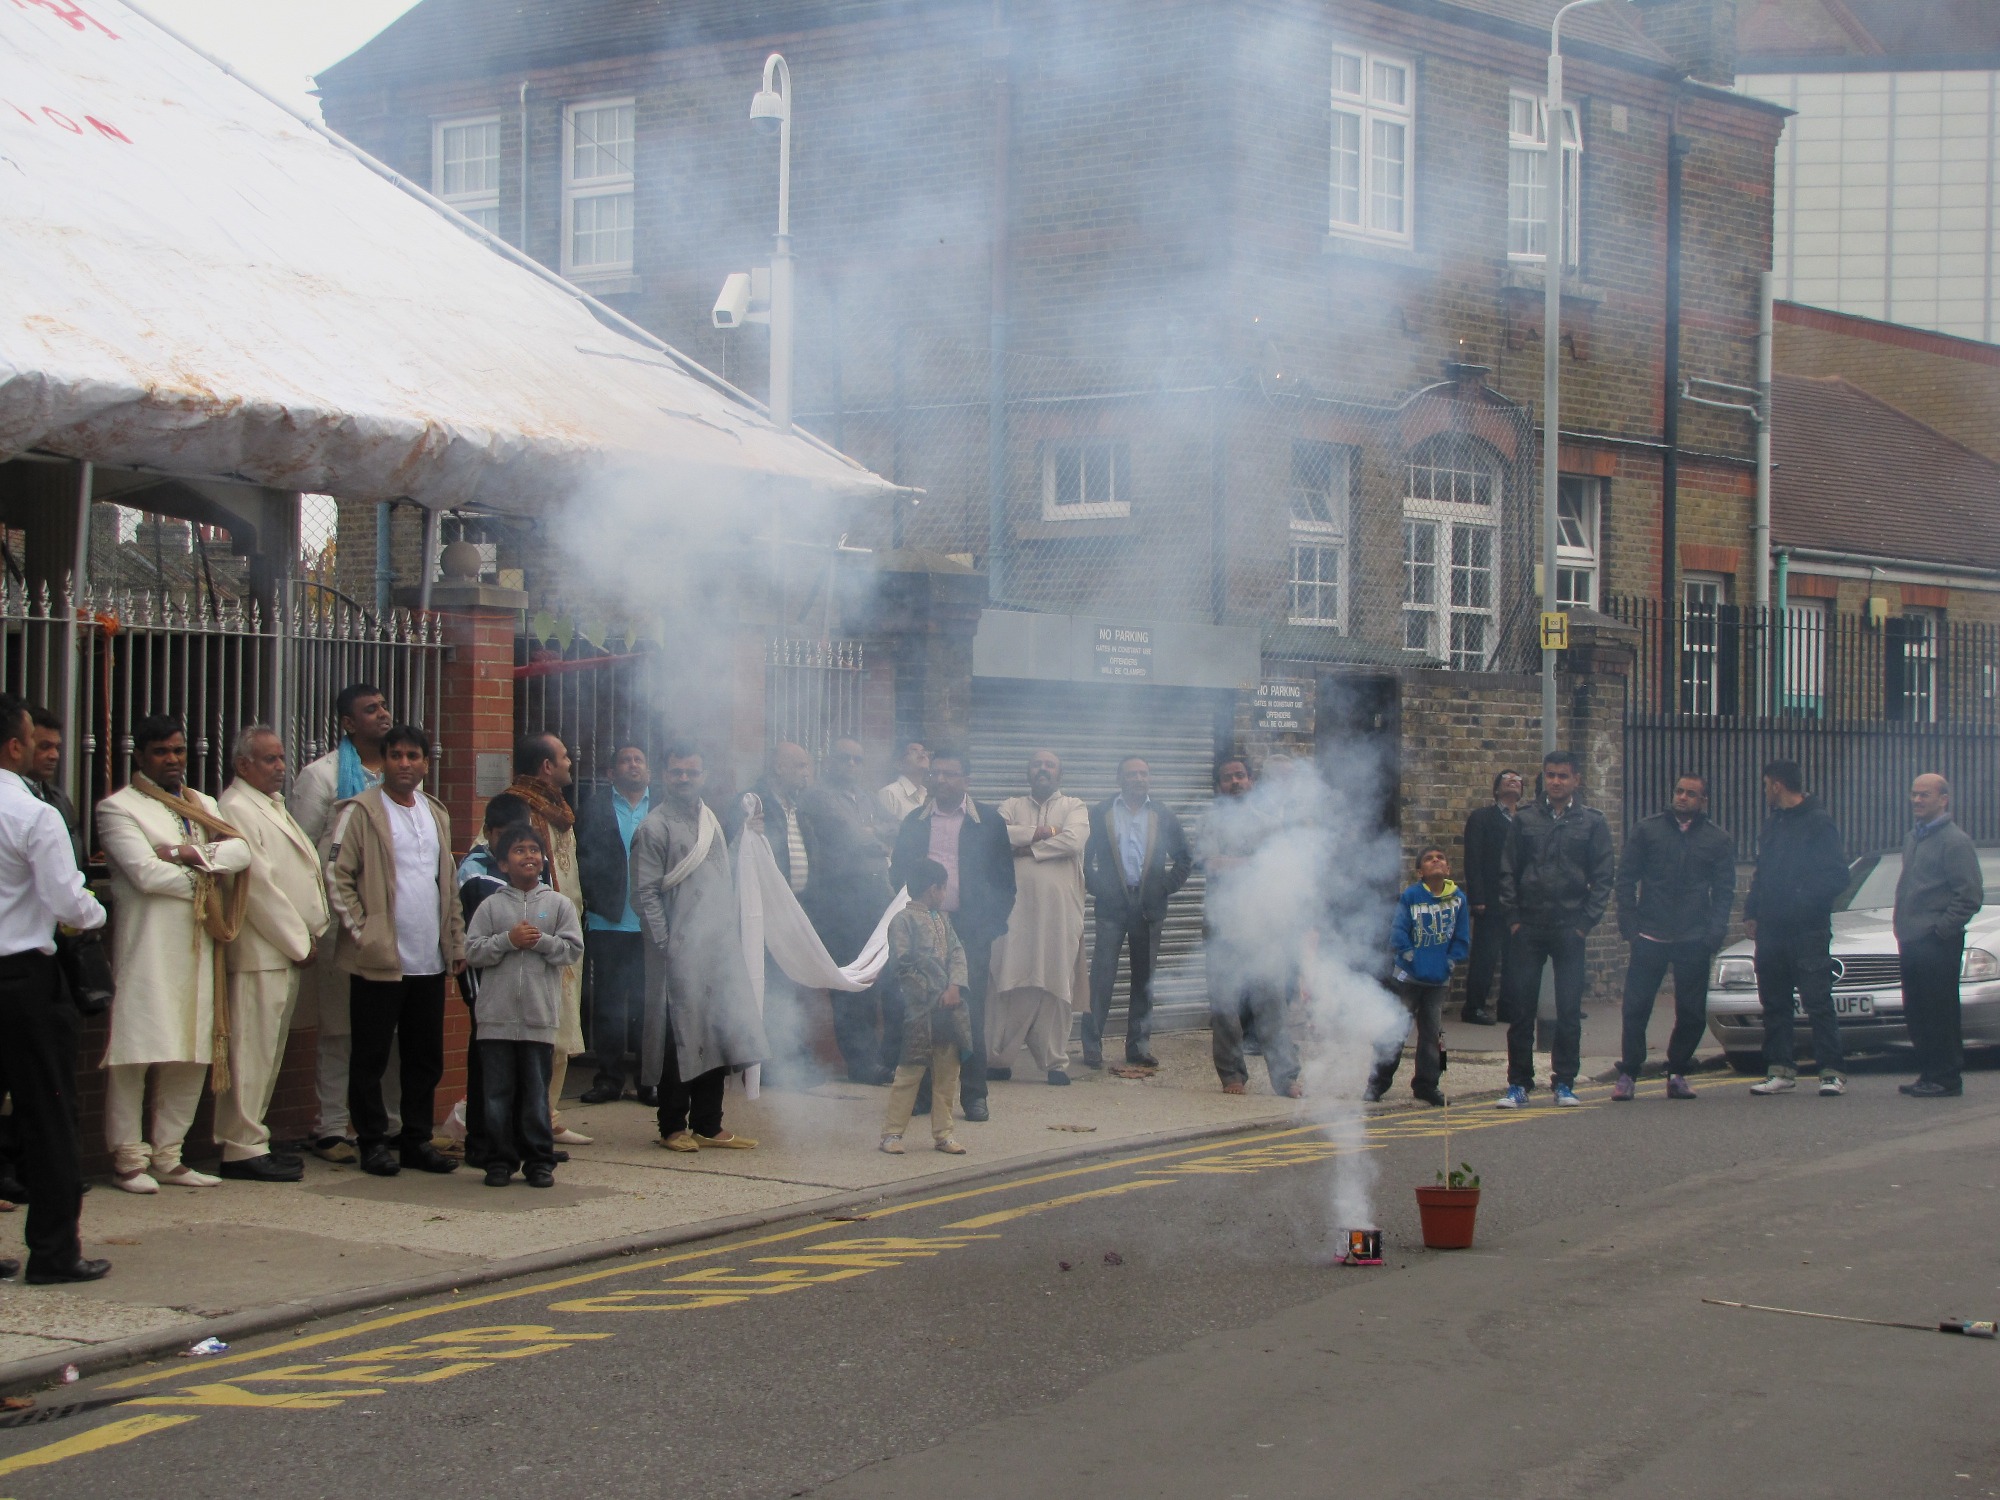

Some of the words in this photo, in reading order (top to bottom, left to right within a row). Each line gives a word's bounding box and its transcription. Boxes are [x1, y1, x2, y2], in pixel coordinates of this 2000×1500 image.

[1100, 629, 1112, 640] NO
[1115, 630, 1148, 643] PARKING
[1110, 657, 1137, 666] OFFENDERS
[1258, 685, 1268, 696] NO
[1271, 686, 1300, 697] PARKING
[1836, 996, 1870, 1013] UFC
[113, 1324, 616, 1409] KEEP
[547, 1234, 1002, 1312] CLEAR
